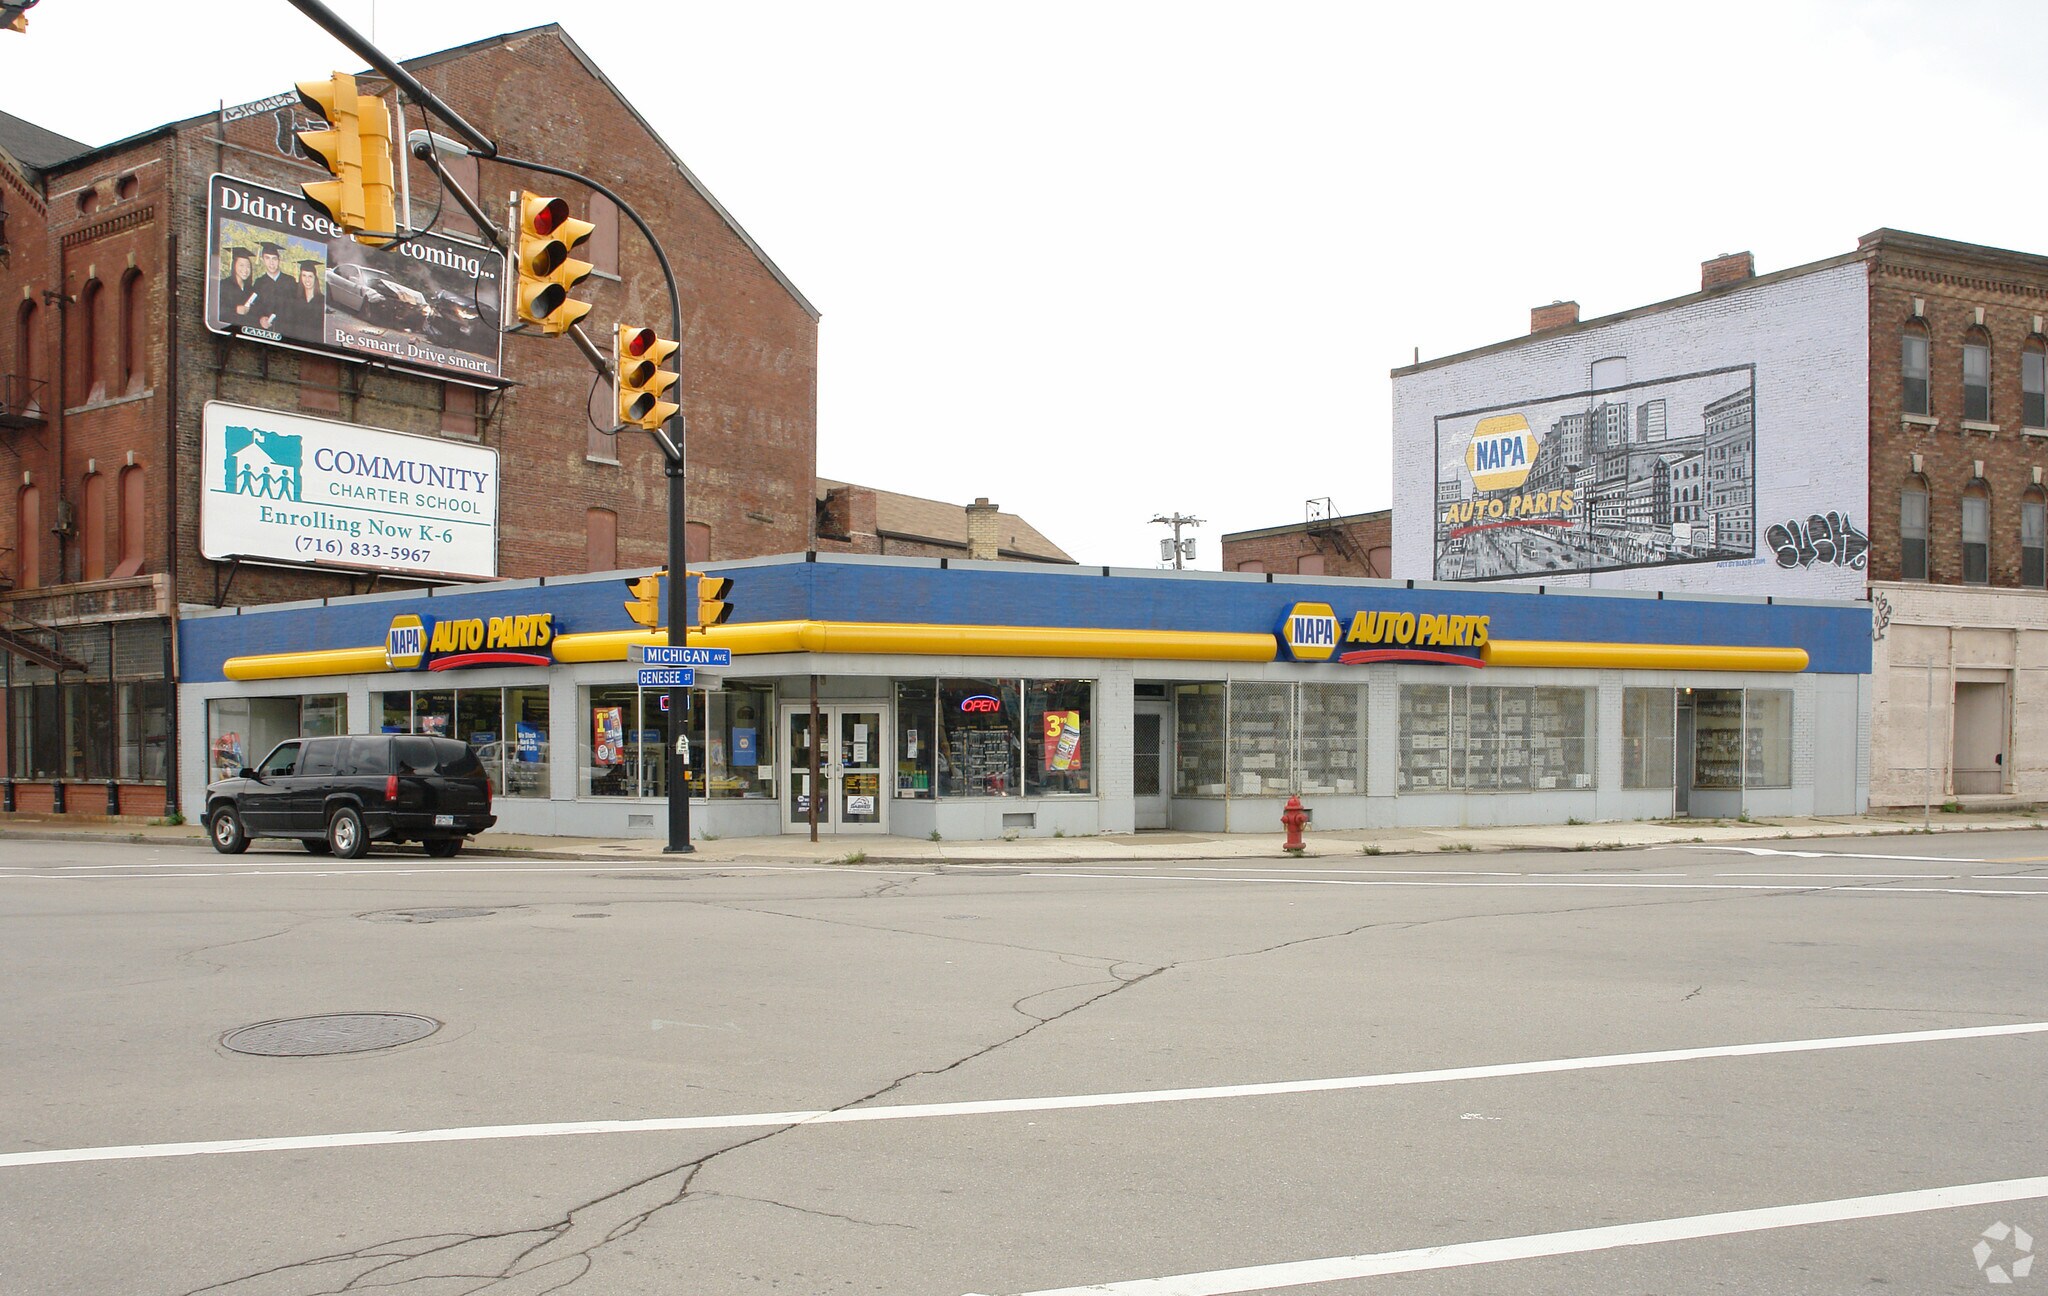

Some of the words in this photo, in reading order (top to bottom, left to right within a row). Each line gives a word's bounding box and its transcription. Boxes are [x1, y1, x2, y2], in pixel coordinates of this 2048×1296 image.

[221, 186, 296, 226] Didn't
[301, 213, 343, 238] see
[334, 329, 354, 344] Be
[358, 337, 404, 355] smart.
[407, 345, 445, 362] Drive
[448, 355, 492, 373] smart.
[1476, 435, 1526, 471] NAPA
[314, 448, 489, 494] COMMUNITY
[329, 482, 409, 505] CHARTER
[415, 494, 481, 515] SCHOOL
[1445, 499, 1503, 525] AUTO
[1507, 490, 1574, 519] PARTS
[260, 506, 361, 537] Enrolling
[368, 519, 412, 540] Now
[419, 524, 453, 544] K-6
[295, 535, 343, 557] (716)
[350, 543, 431, 563] 833-5967
[391, 628, 420, 654] NAPA
[430, 618, 484, 653] AUTO
[487, 613, 554, 649] PARTS
[1294, 618, 1333, 644] NAPA
[1346, 610, 1416, 644] AUTO
[1416, 613, 1490, 646] PARTS
[647, 648, 710, 662] MICHIGAN
[640, 671, 681, 684] GENESEE
[684, 673, 691, 681] ST
[963, 700, 1000, 712] OPEN
